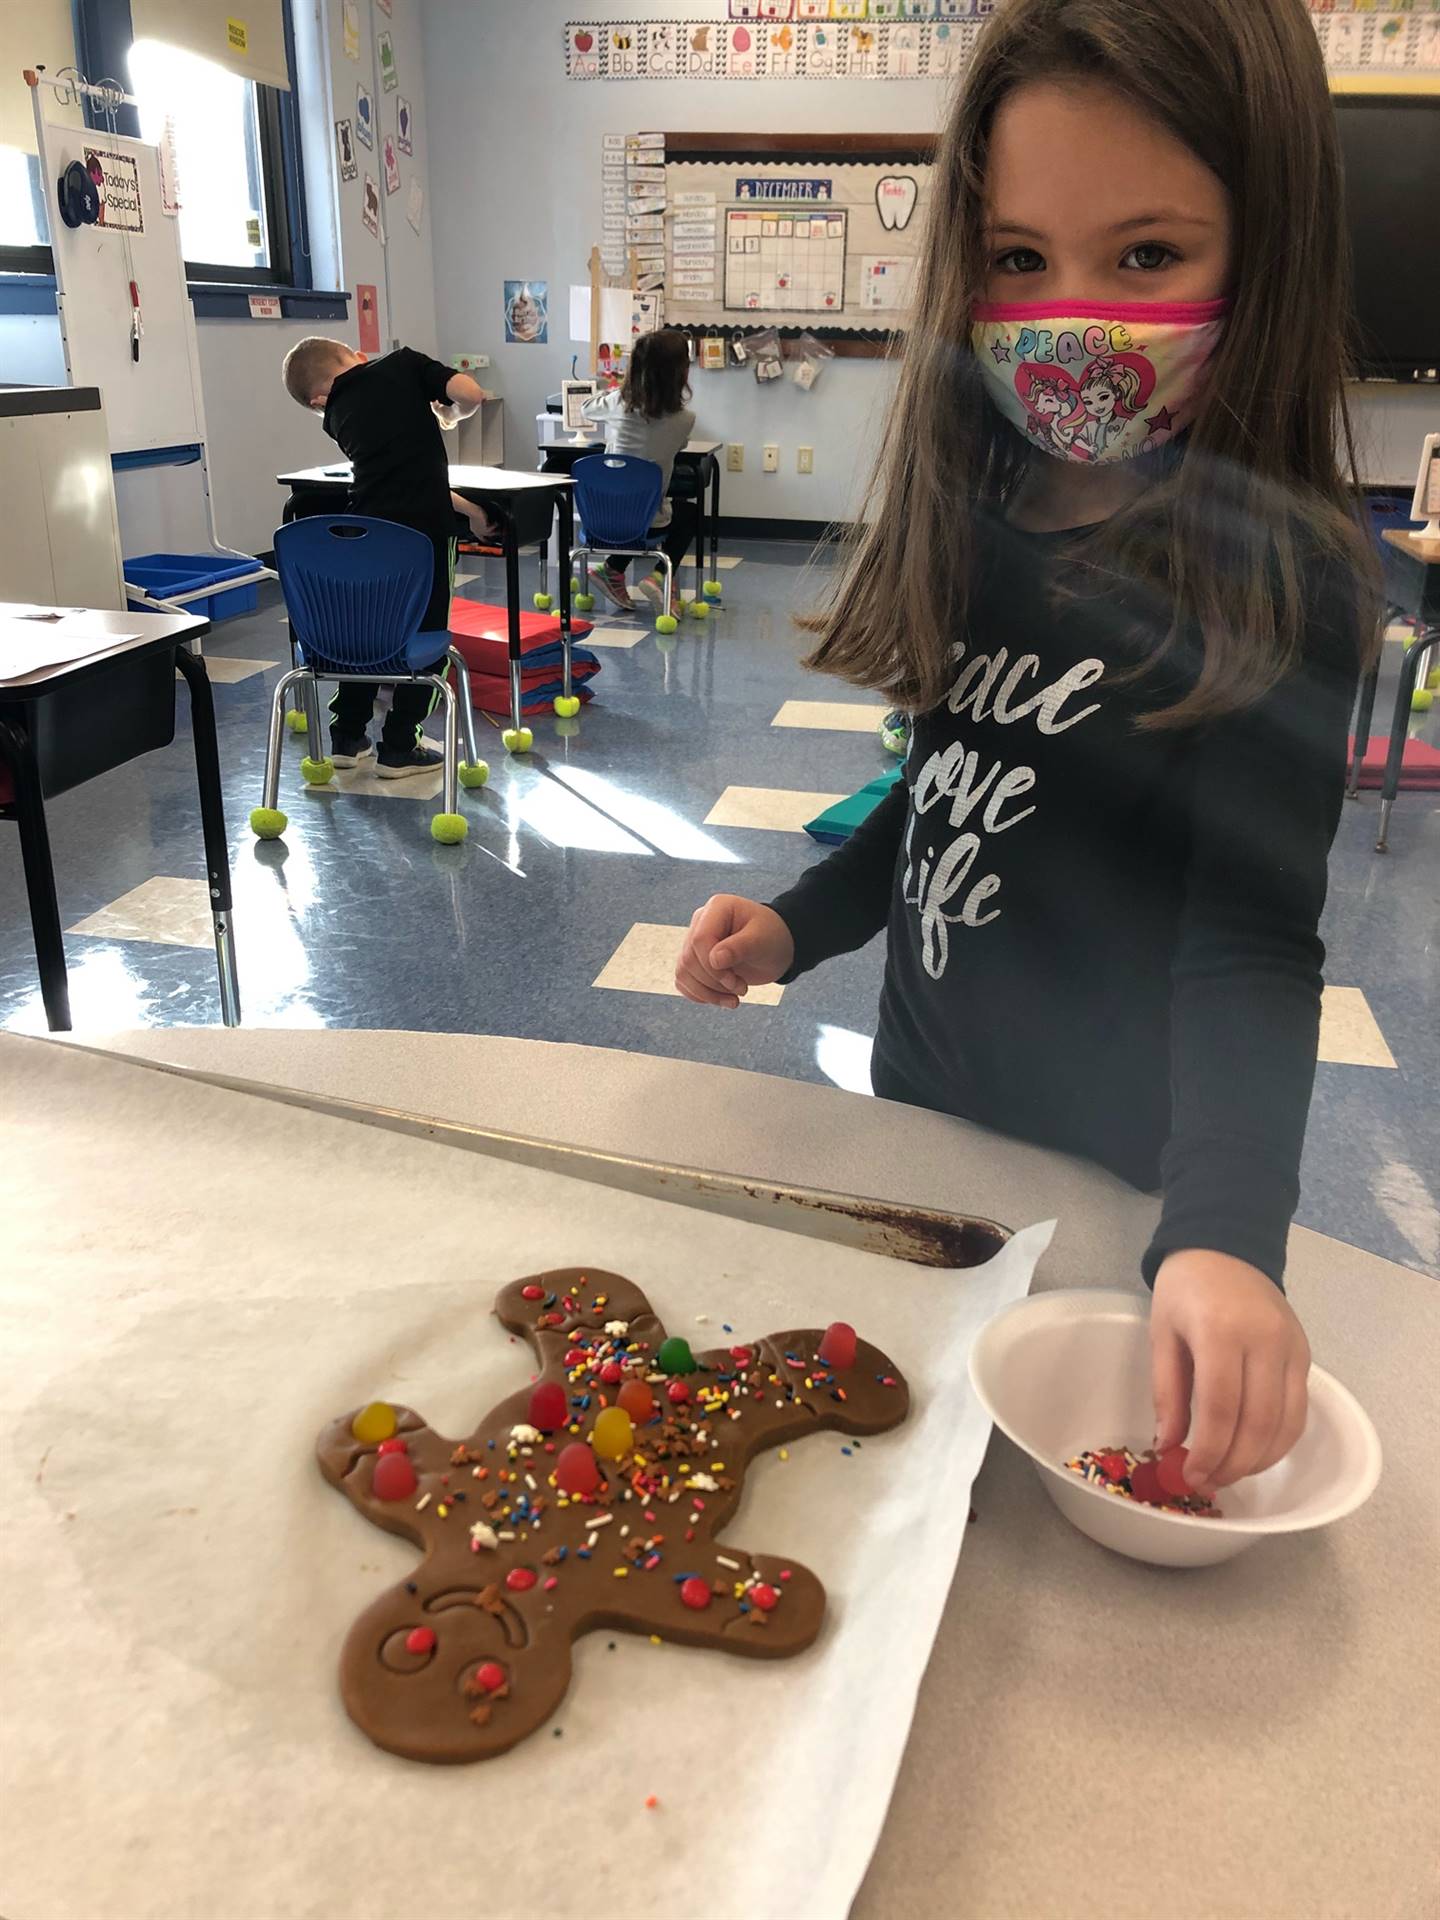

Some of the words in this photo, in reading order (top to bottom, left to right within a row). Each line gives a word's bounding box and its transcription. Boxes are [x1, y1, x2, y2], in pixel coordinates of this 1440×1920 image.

[573, 54, 597, 73] Aa
[612, 53, 633, 73] Bb
[650, 53, 673, 73] Cc
[689, 53, 713, 73] Dd
[730, 53, 752, 73] Ee
[771, 53, 793, 73] Ff
[810, 52, 833, 74] Gg
[850, 53, 875, 73] Hh
[755, 181, 813, 200] DECEMBER
[107, 193, 138, 212] Special
[1015, 325, 1133, 363] PEACE
